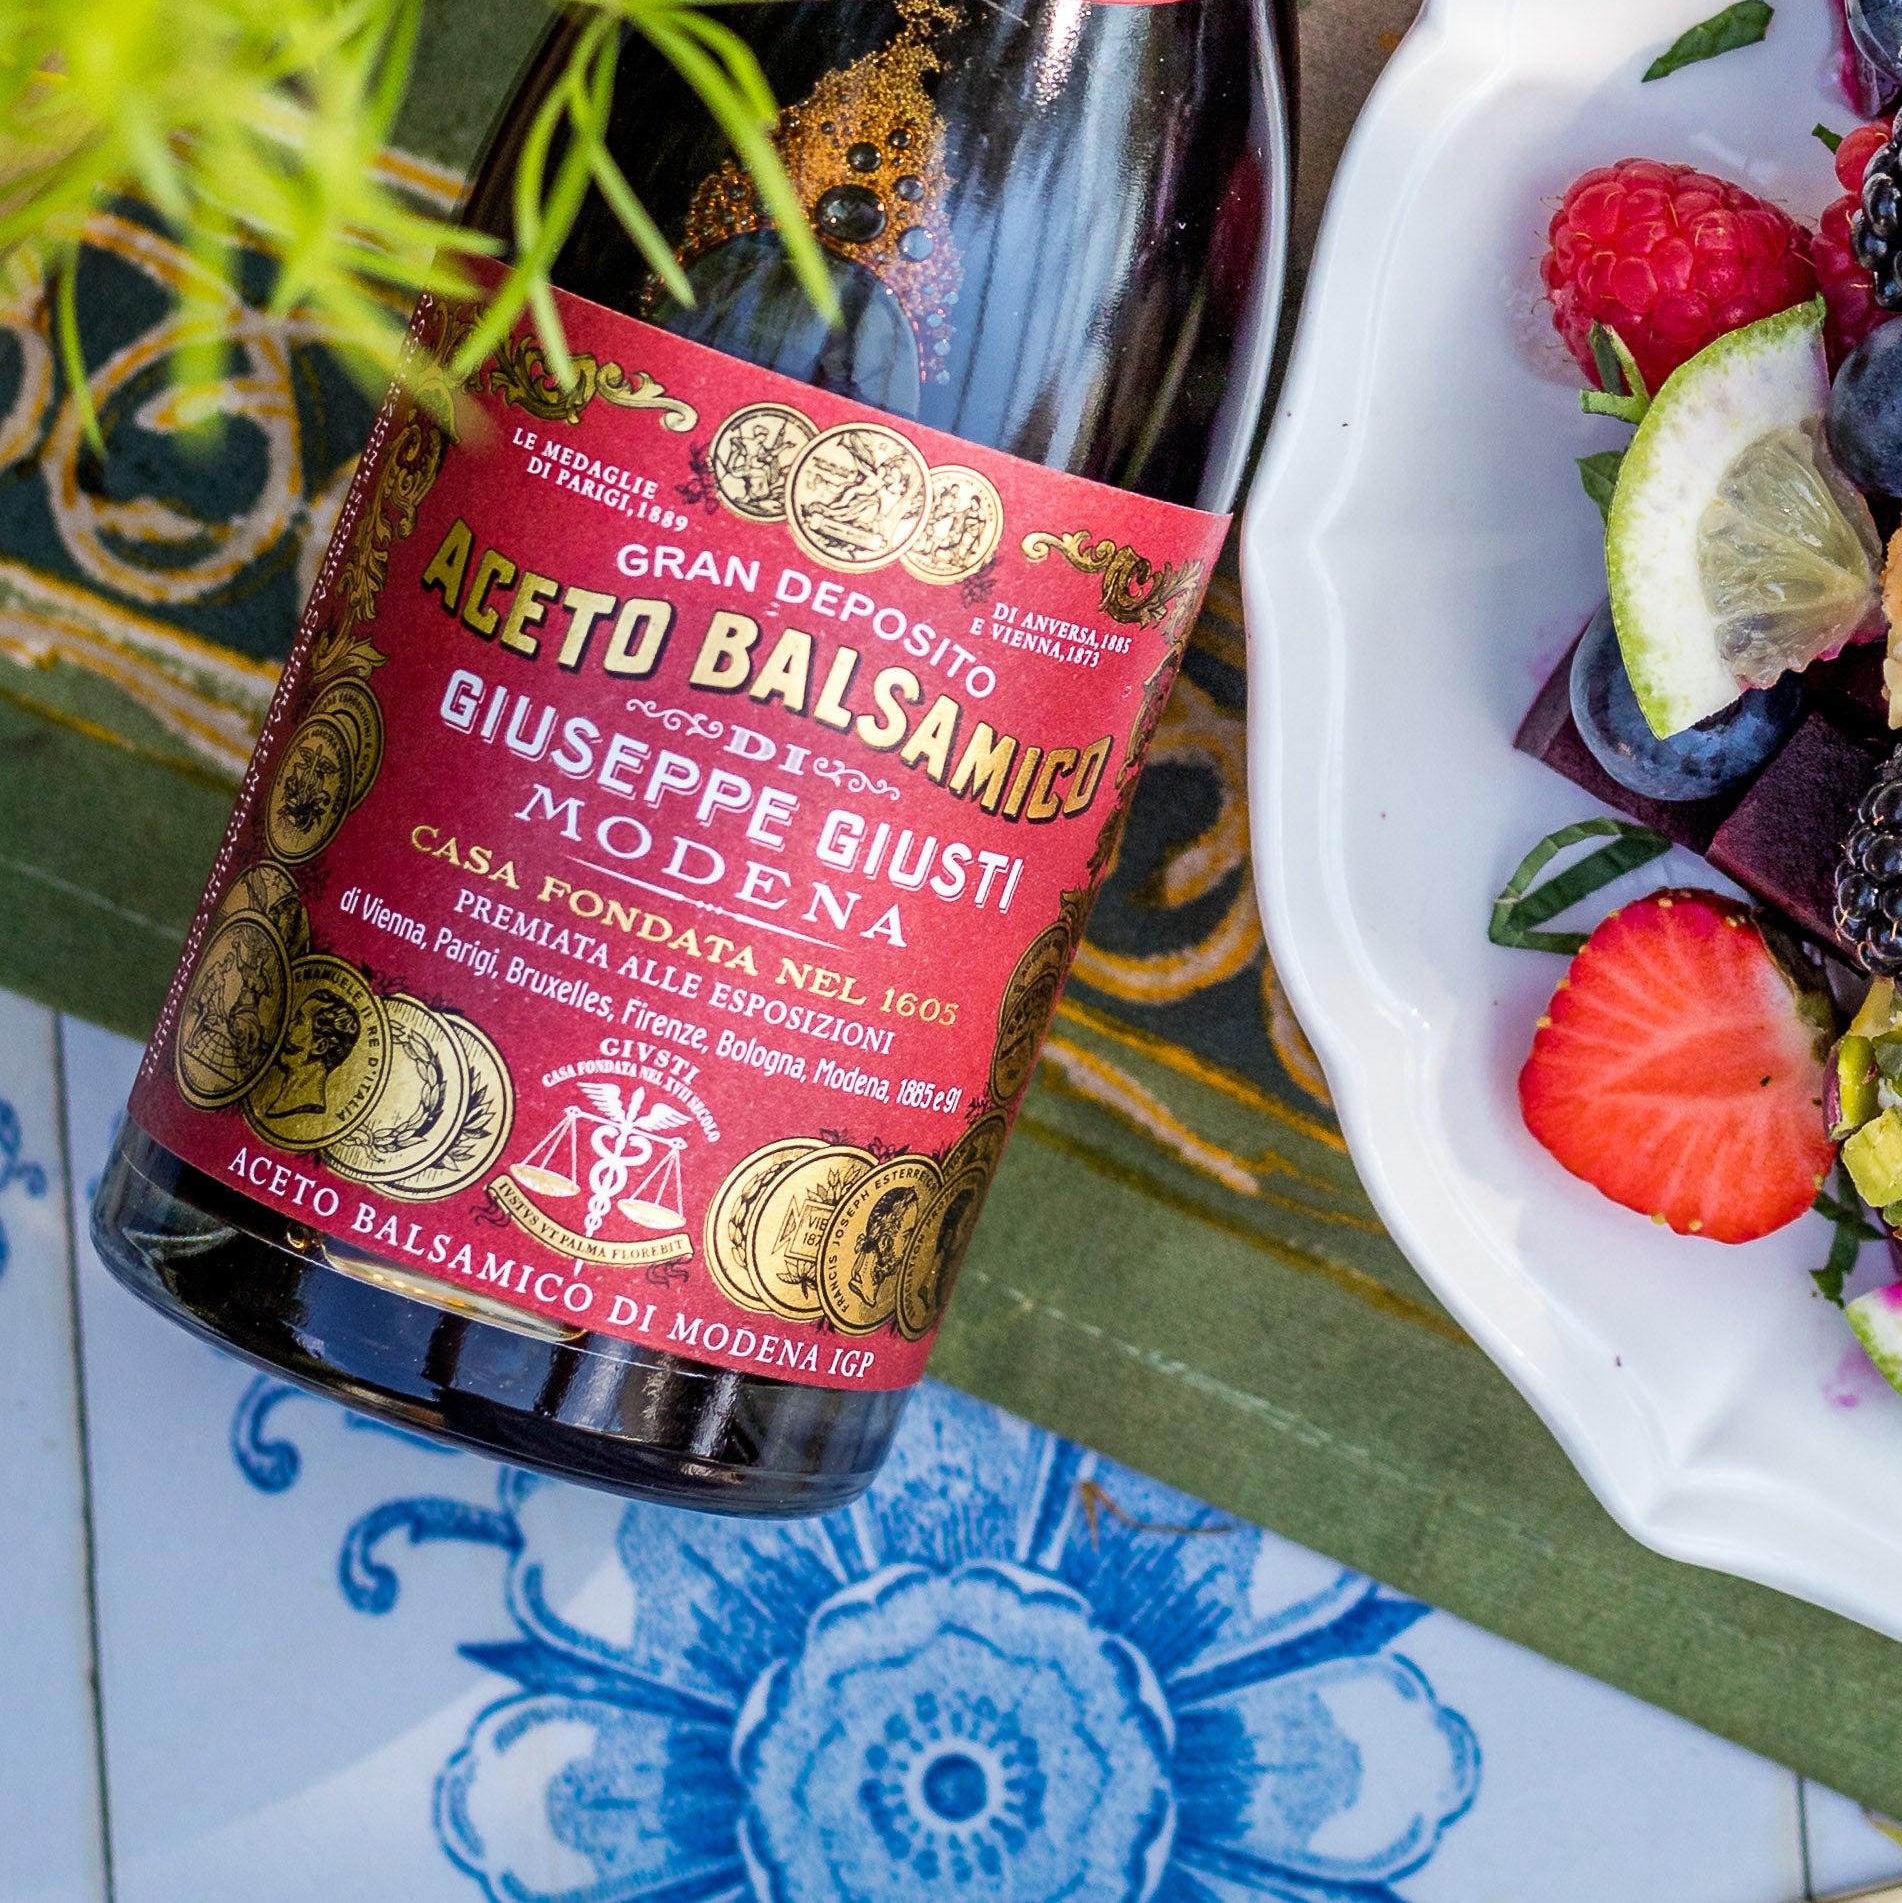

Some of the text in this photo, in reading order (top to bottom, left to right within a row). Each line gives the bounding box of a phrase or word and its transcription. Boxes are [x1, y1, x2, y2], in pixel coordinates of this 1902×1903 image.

[513, 428, 659, 499] LE MEDAGLIE
[527, 456, 552, 479] DI
[616, 543, 997, 698] GRAN DEPOSITO
[969, 617, 985, 636] E
[992, 602, 1018, 623] DI
[420, 516, 1114, 825] ACETO BALSAMICO
[722, 724, 811, 776] DI
[439, 668, 800, 851] GIUSEPPE
[816, 809, 1025, 914] GIUSTI
[514, 783, 908, 948] MODENA
[411, 825, 520, 889] CASA
[537, 875, 759, 976] FONDATA
[774, 957, 867, 1006] NEL
[879, 987, 960, 1026] 1605
[339, 886, 963, 1114] di Vienna, Parigi, Bruxelles, Firenze, Bologna, Modena, 1885 e 91
[453, 888, 896, 1055] PREMIATA ALLE ESPOSIZIONI
[366, 1024, 380, 1049] RE
[600, 1037, 701, 1086] GIVSTI
[541, 1059, 722, 1144] CASA FONDATA NEL XVII SECOLO
[498, 1181, 684, 1261] IVSTVS VT PALMA FLOREBIT
[802, 1231, 823, 1246] 187
[834, 1189, 871, 1247] JOSEPH
[228, 1147, 875, 1379] ACETO BALSAMICO DI MODENA IGP
[827, 1254, 850, 1314] FRANCIS
